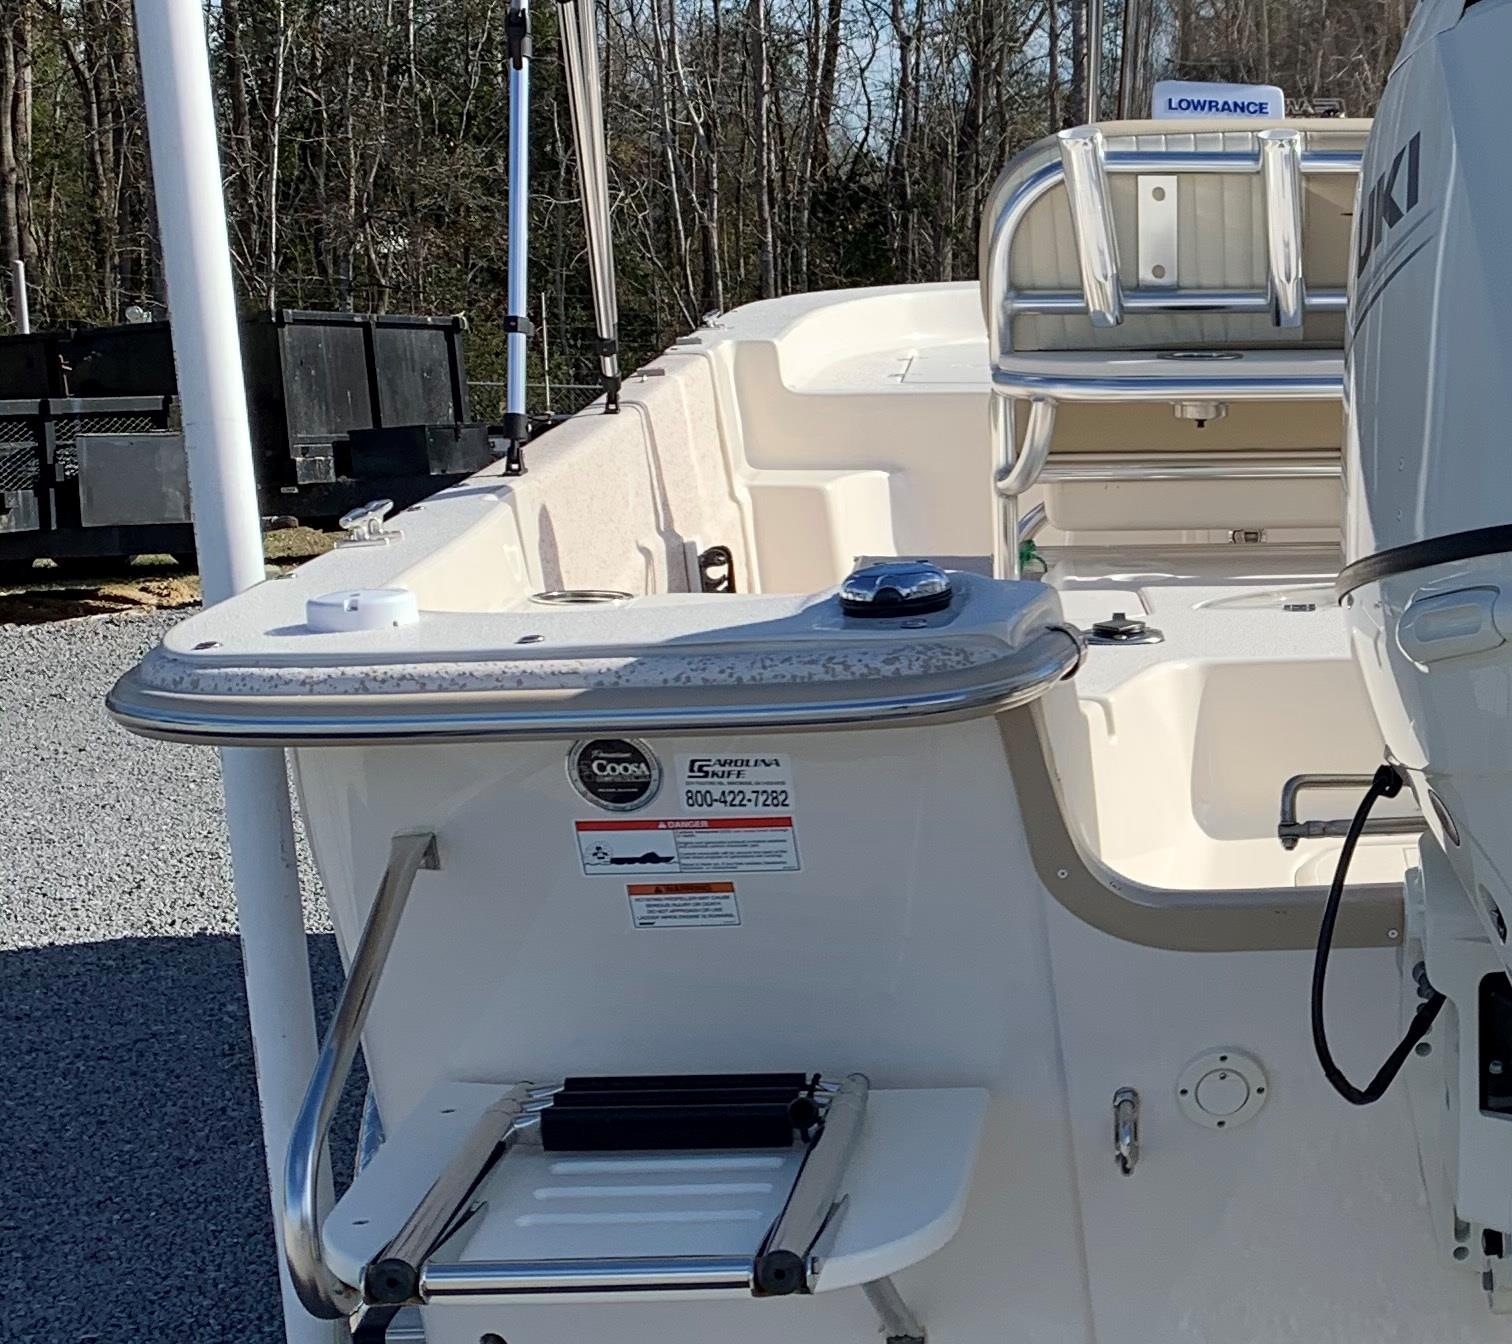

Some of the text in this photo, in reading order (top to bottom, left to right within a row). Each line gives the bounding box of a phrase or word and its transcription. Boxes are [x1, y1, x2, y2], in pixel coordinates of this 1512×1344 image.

[1167, 97, 1270, 115] LOWRANCE
[591, 759, 651, 777] COOSA
[688, 757, 781, 770] CAROLINA
[687, 765, 747, 779] SKIFF
[685, 789, 790, 808] 800-422-7282
[666, 820, 709, 829] DANGER
